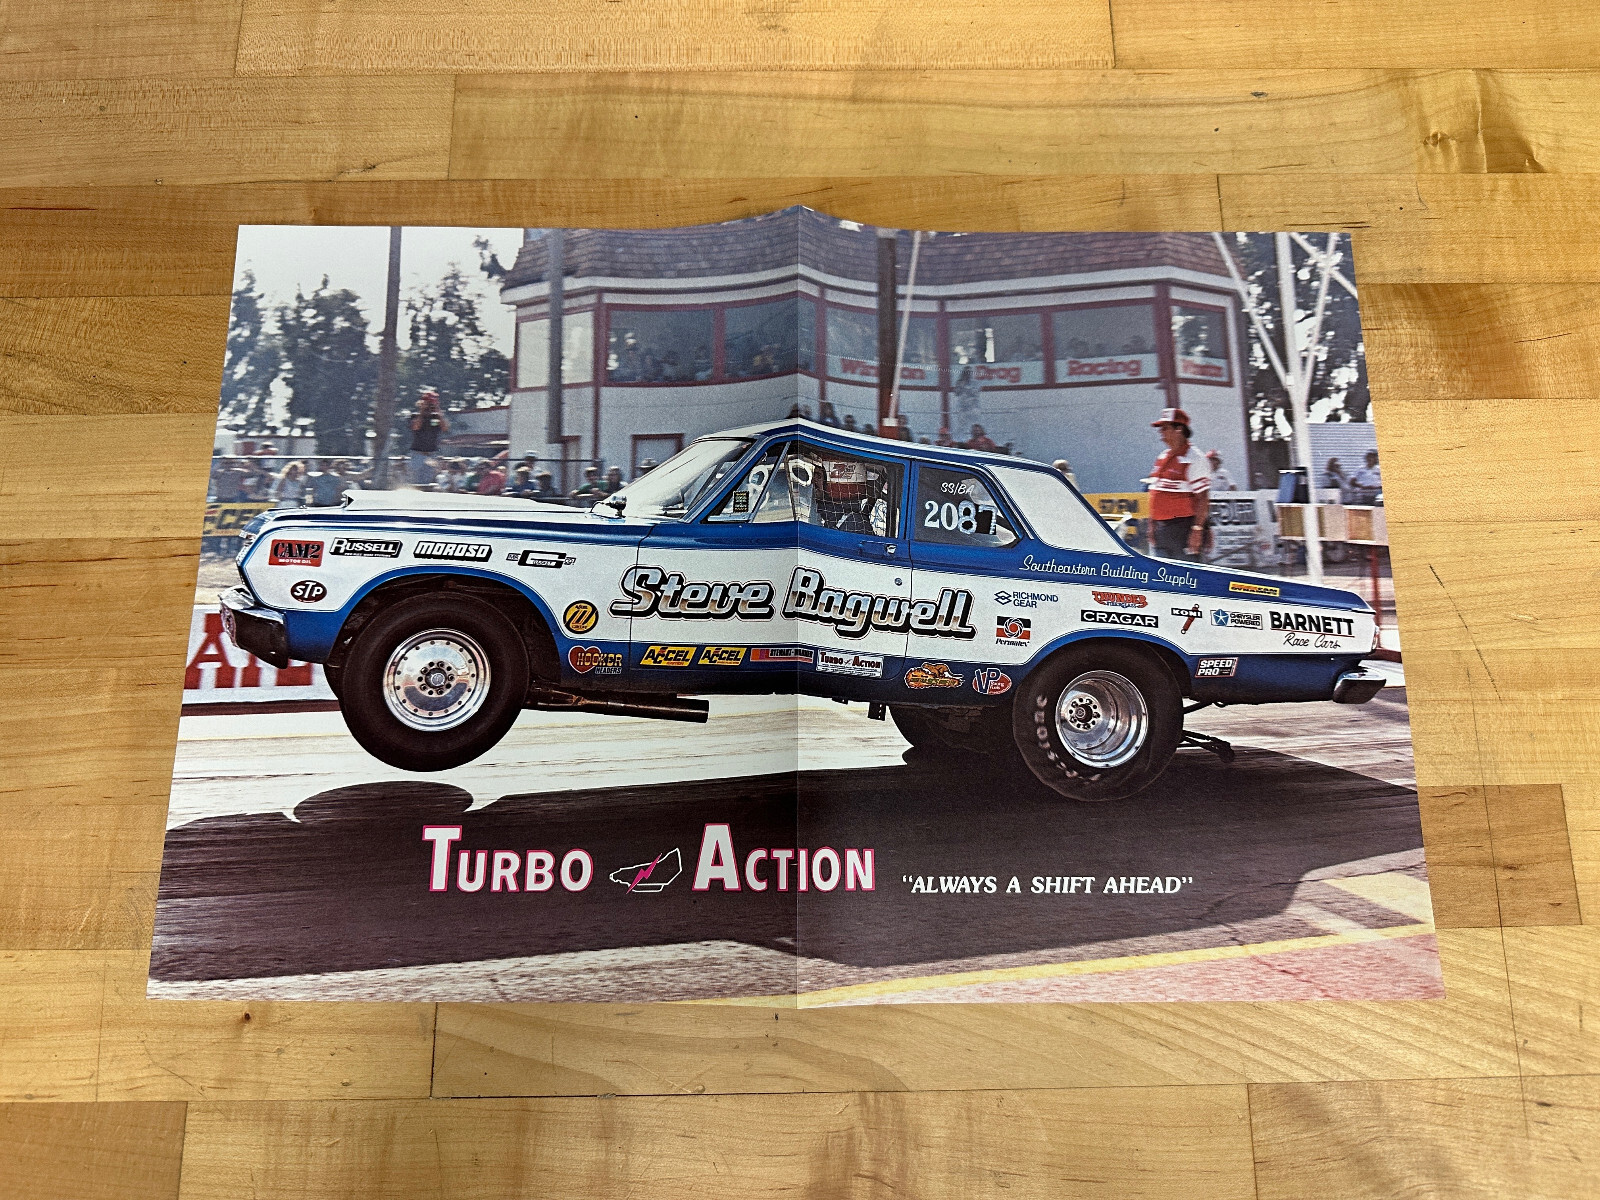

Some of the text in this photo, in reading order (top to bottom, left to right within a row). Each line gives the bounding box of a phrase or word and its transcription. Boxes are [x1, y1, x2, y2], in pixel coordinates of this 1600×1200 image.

[924, 500, 998, 535] 2087
[273, 542, 321, 558] CAM2
[329, 538, 396, 553] RUSSELL
[414, 541, 491, 560] MOROSO
[1019, 554, 1198, 588] Southeastern Building Supply
[293, 582, 324, 599] STP
[1012, 591, 1059, 603] RICHMOND
[608, 564, 977, 640] Steve Bagwell
[1013, 599, 1038, 608] GEAR
[1083, 611, 1157, 627] CRAGAR
[1172, 608, 1201, 617] KONI
[1230, 612, 1261, 621] CHRYSLER
[1269, 610, 1354, 635] BARNETT
[1283, 632, 1341, 649] Race Cars
[576, 652, 623, 667] HOOKER
[1200, 660, 1232, 668] SPEED
[1197, 668, 1220, 676] PRO
[422, 822, 876, 893] TURBO ACTION
[1005, 875, 1022, 894] A
[1030, 875, 1096, 894] SHIFT
